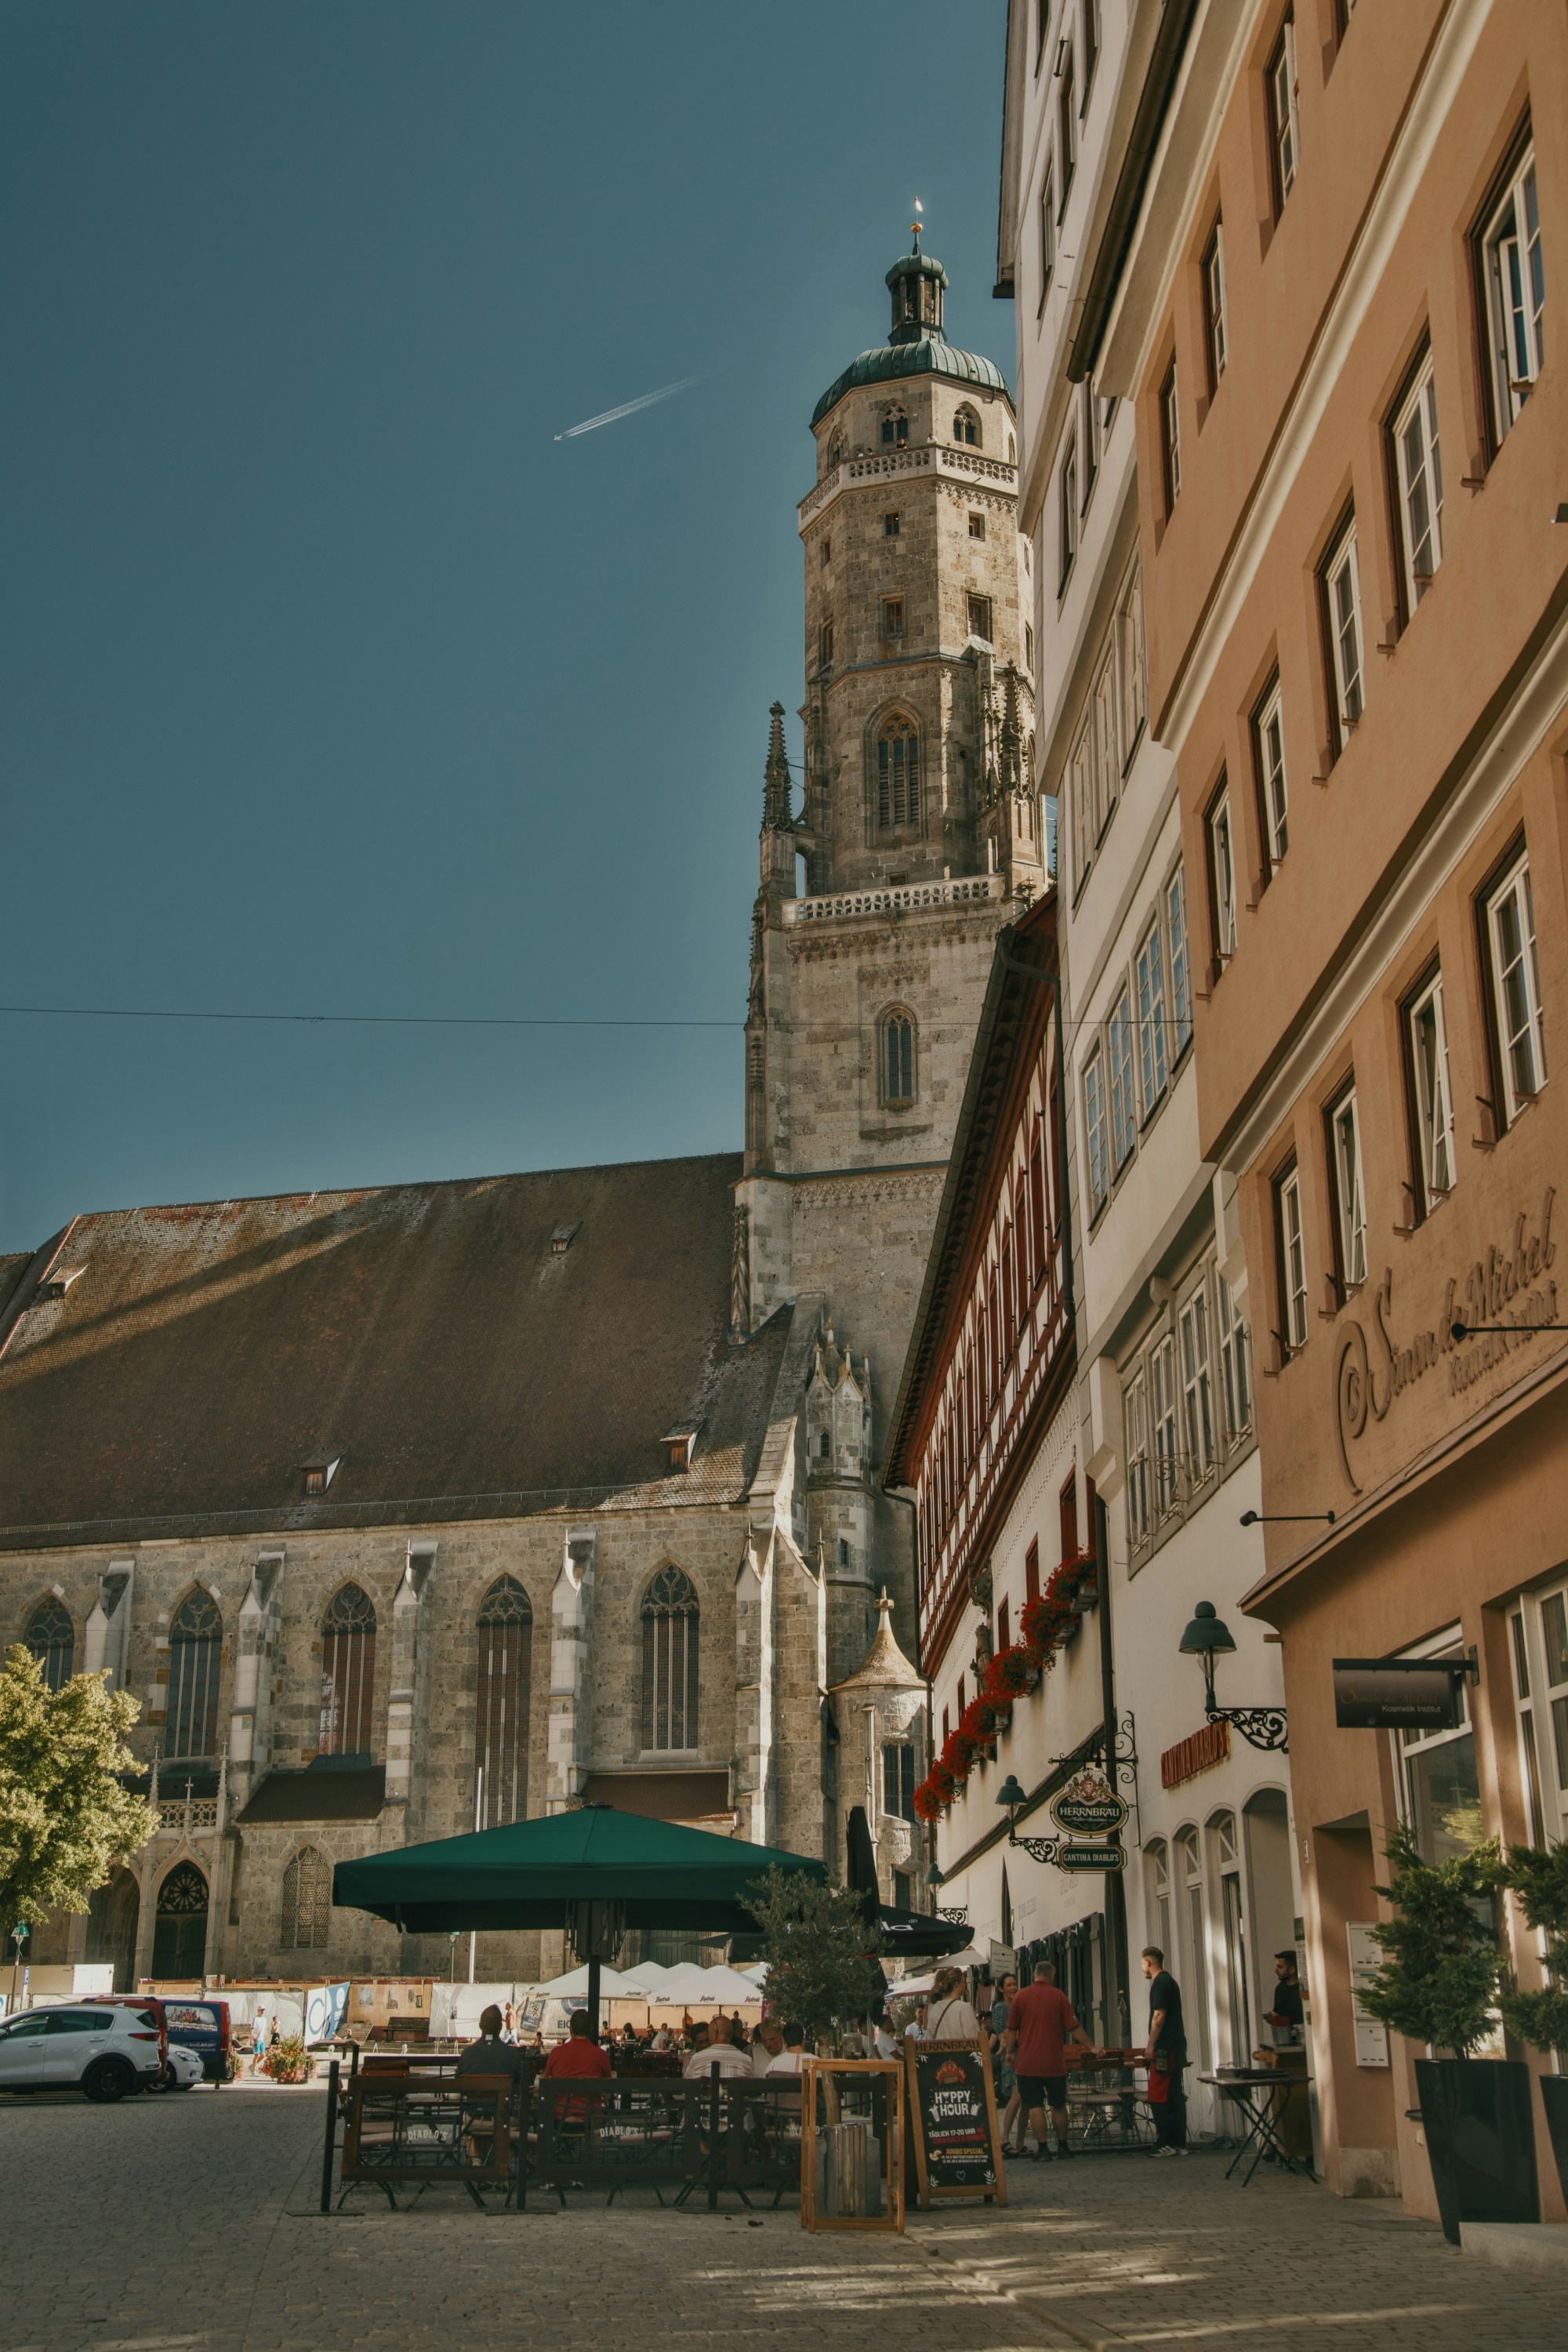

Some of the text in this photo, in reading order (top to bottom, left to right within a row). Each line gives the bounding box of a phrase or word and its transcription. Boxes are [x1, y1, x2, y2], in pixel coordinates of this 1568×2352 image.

[1367, 1267, 1439, 1421] Simon
[1465, 1186, 1556, 1340] Michel
[1446, 1320, 1510, 1398] Kosmetik
[1341, 1682, 1381, 1704] Simon
[1161, 1737, 1192, 1789] CANTINA
[1060, 1807, 1120, 1817] HERRNBRÄU
[1092, 1853, 1120, 1862] DIABLO'S
[939, 2103, 970, 2117] HOUR
[408, 2129, 448, 2141] DIABLO'S
[928, 2129, 949, 2139] TÄGLICH
[964, 2127, 976, 2136] UHR
